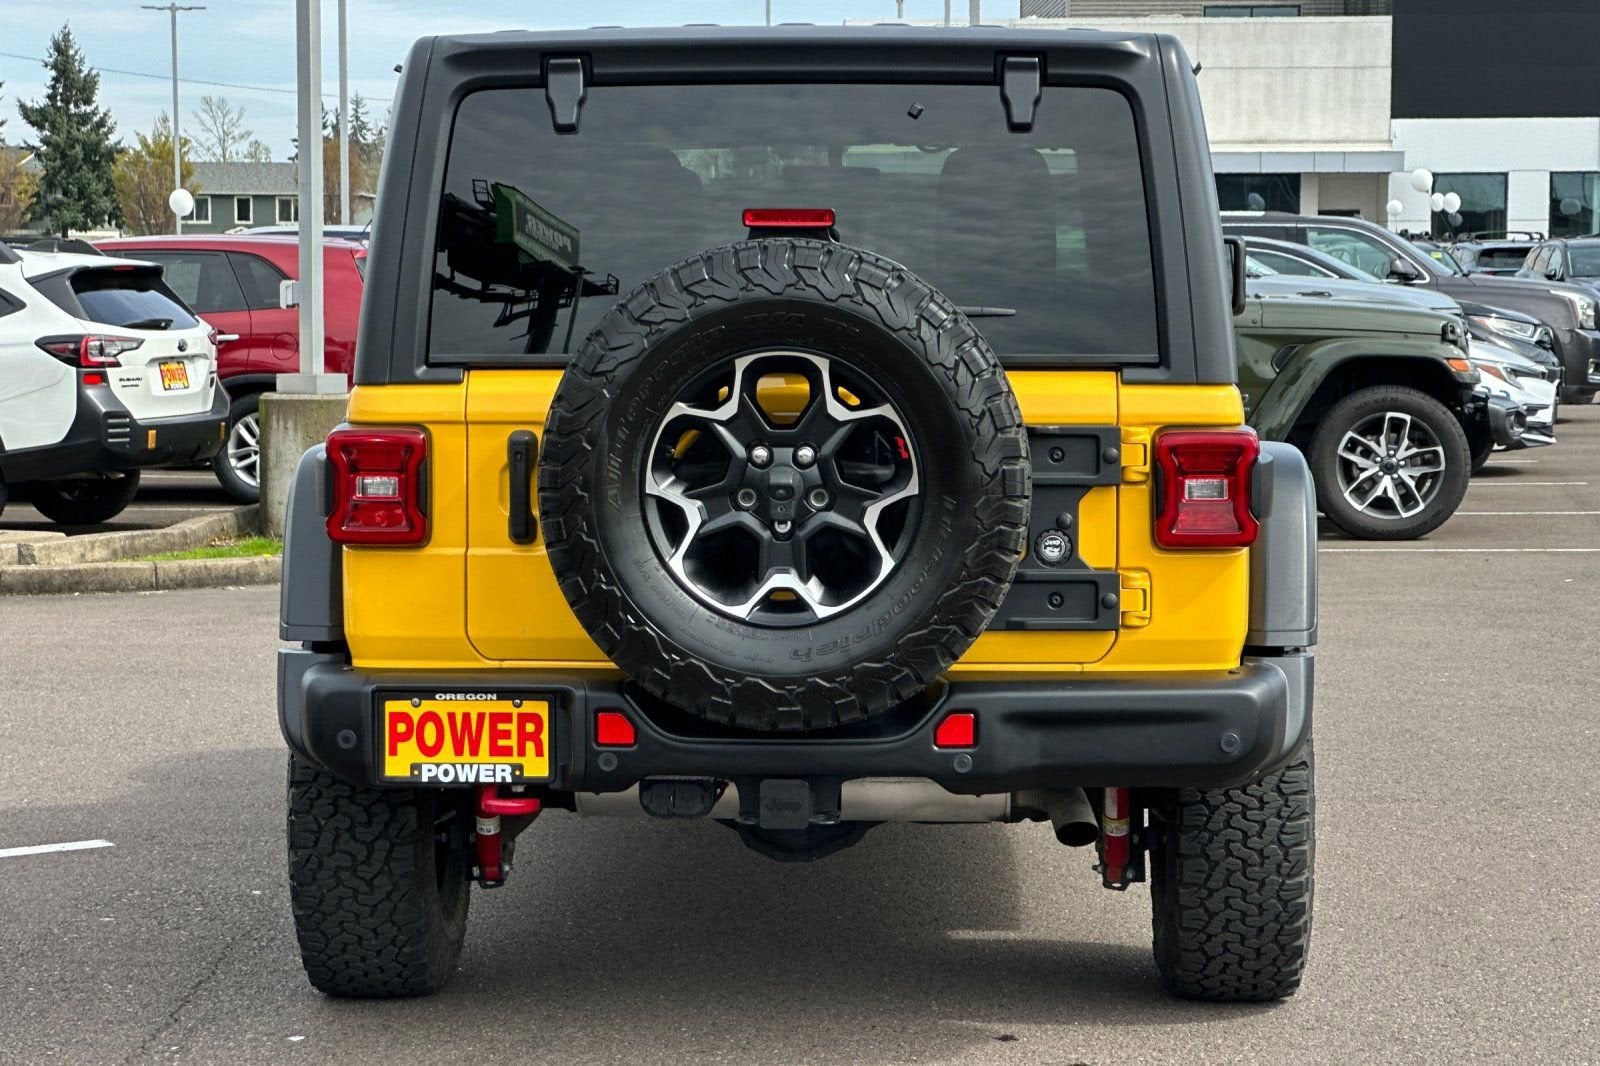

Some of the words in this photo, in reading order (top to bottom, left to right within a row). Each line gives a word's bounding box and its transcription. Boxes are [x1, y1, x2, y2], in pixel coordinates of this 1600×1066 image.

[162, 367, 185, 381] POWER
[435, 693, 497, 701] OREGON
[388, 711, 545, 758] POWER
[421, 763, 513, 783] POWER
